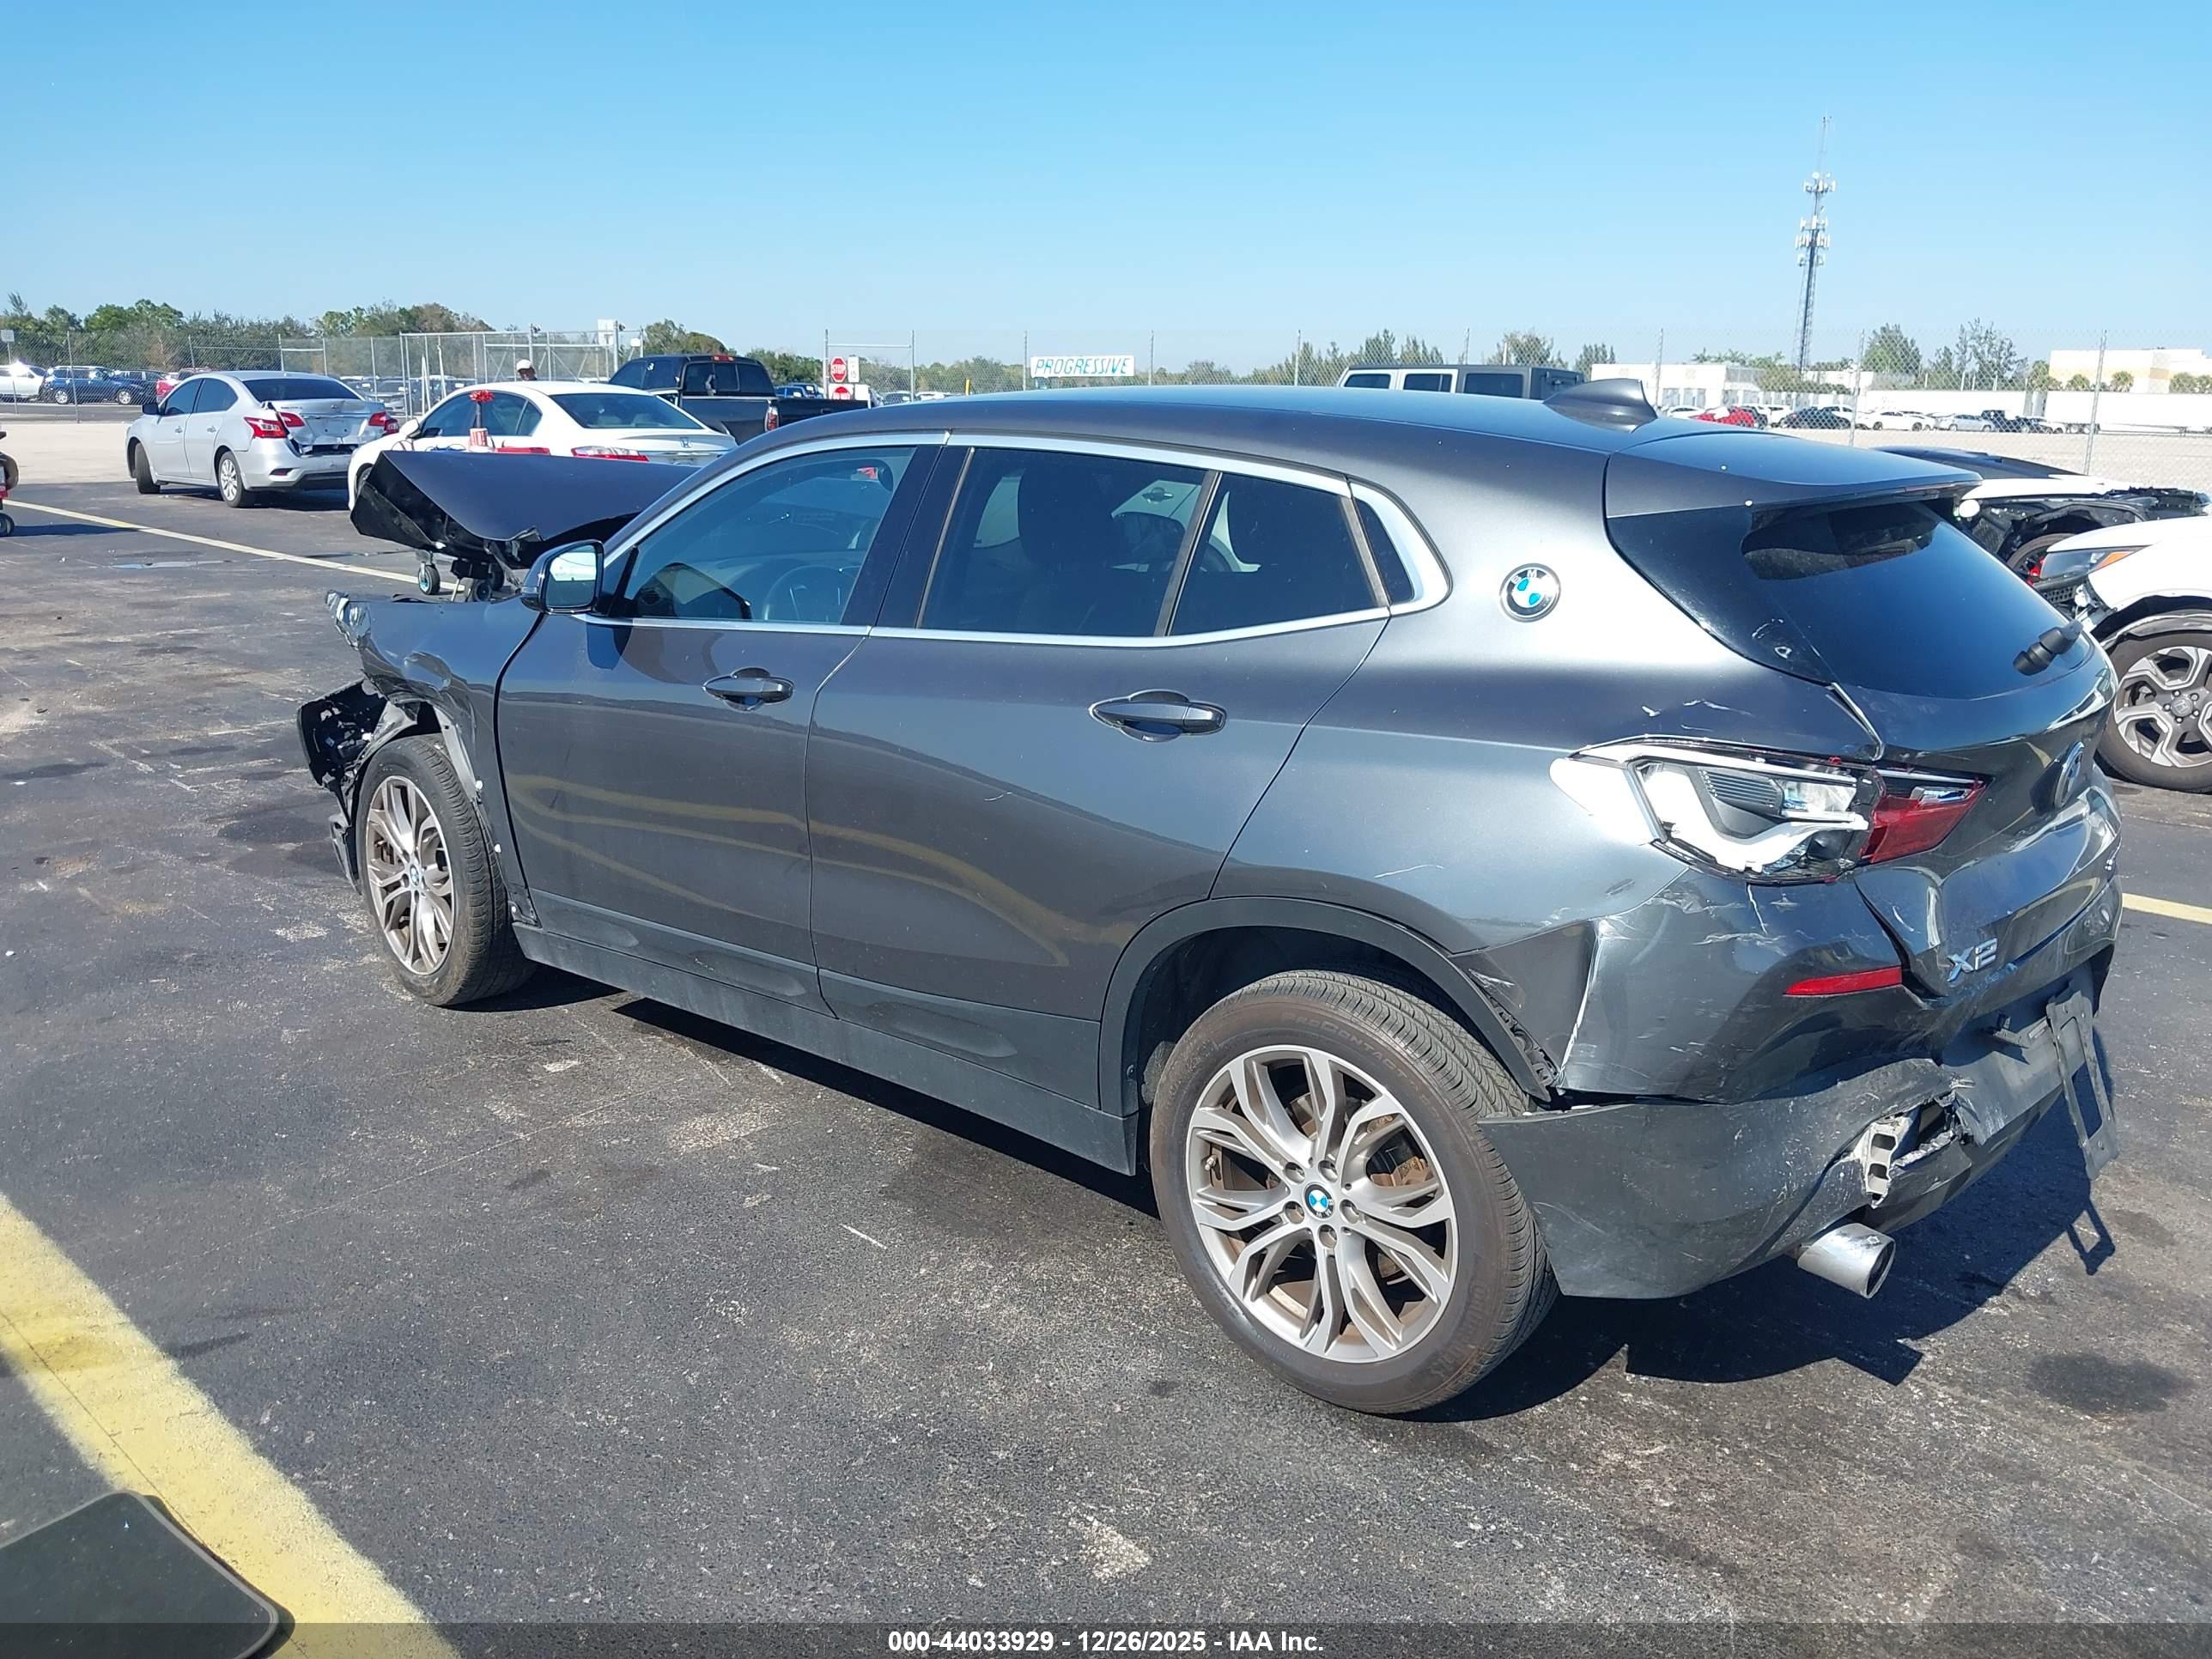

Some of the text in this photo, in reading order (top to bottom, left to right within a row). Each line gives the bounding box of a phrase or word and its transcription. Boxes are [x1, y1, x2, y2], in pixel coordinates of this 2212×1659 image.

[830, 363, 847, 374] STOP
[1034, 357, 1131, 375] PROGRESSIVE
[1947, 937, 1998, 983] X2
